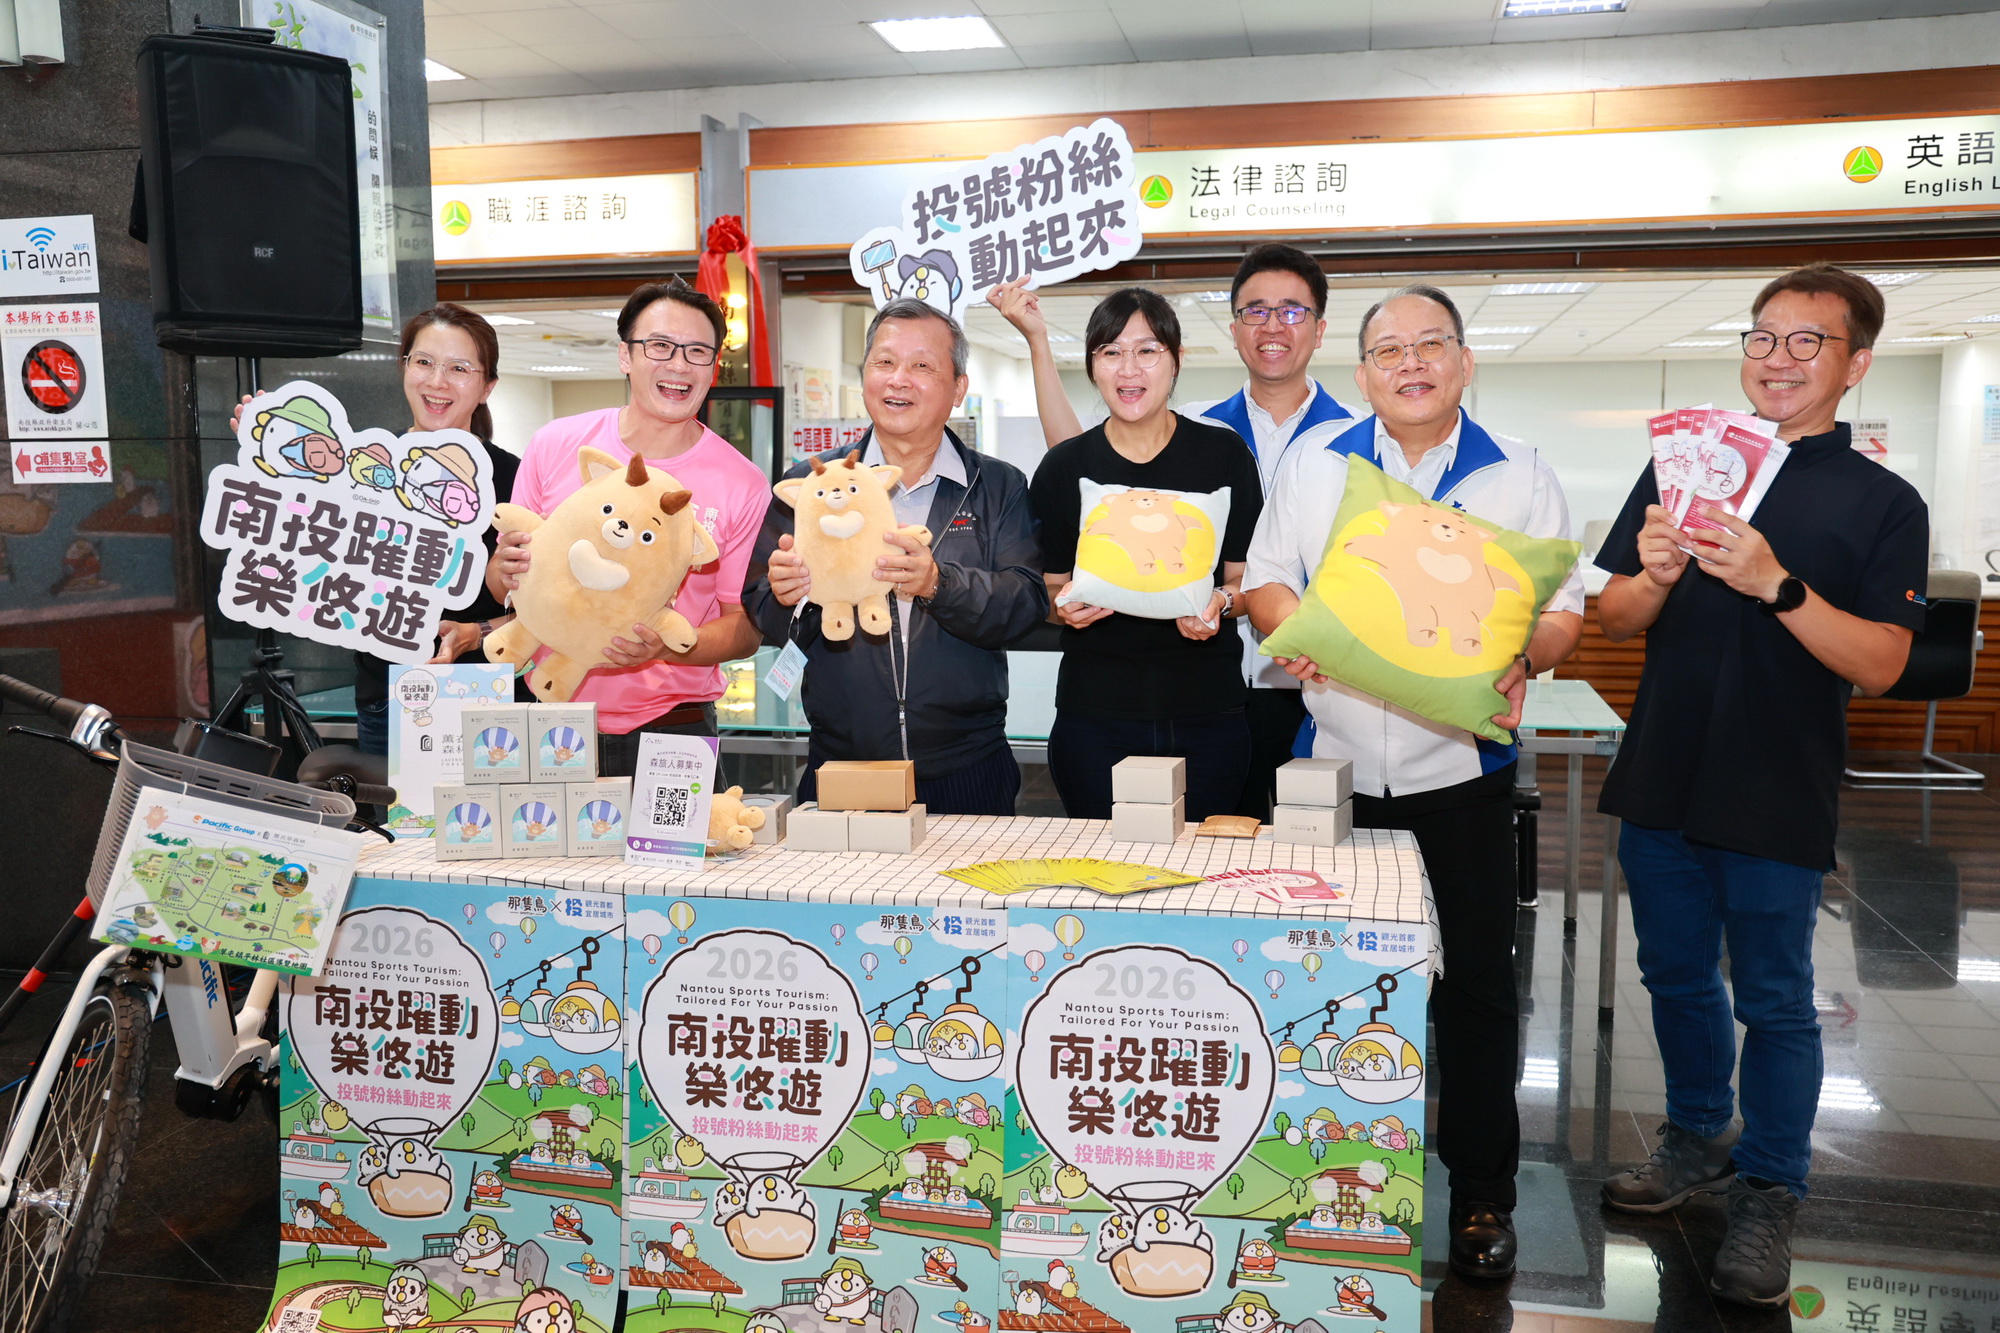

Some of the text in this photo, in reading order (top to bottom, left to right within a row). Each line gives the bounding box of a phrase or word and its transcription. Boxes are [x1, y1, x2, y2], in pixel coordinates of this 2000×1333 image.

[1907, 131, 1995, 169] 英語
[913, 132, 1123, 245] 投號粉絲
[1191, 162, 1347, 197] 法律諮詢
[1905, 177, 1982, 197] English
[488, 193, 627, 223] 職涯諮詢
[1190, 202, 1345, 221] Legal Counseling
[254, 247, 274, 257] RCF
[969, 199, 1131, 291] 動起來
[5, 310, 96, 324] 本場所全面禁菸
[34, 452, 87, 465] 哺集乳室
[215, 478, 474, 597] 南投躍動
[232, 549, 430, 651] 樂悠遊
[650, 757, 702, 771] 森旅人募集中
[202, 818, 256, 835] Pacific Group
[508, 896, 547, 913] 那隻鳥
[585, 900, 613, 908] 觀光首都
[585, 910, 614, 919] 宜居城市
[880, 914, 924, 931] 那隻鳥
[965, 917, 996, 926] 觀光首都
[350, 923, 434, 958] 2026
[965, 927, 996, 936] 宜居城市
[1288, 929, 1335, 947] 那隻鳥
[1381, 932, 1416, 942] 觀光首都
[1381, 944, 1415, 953] 宜居城市
[326, 957, 462, 976] Nantou Sports Tourism:
[706, 946, 799, 982] 2026
[199, 959, 219, 1009] acific
[322, 968, 469, 988] Tailored For Your Passion
[1094, 963, 1196, 1001] 2026
[680, 984, 829, 1000] Nantou Sports Tourism:
[314, 984, 479, 1040] 南投躍動
[676, 995, 838, 1012] Tailored For Your Passion
[1064, 1002, 1229, 1020] Nantou Sports Tourism:
[1059, 1015, 1239, 1033] Tailored For Your Passion
[667, 1012, 848, 1067] 南投躍動
[331, 1031, 455, 1085] 樂悠遊
[1050, 1032, 1250, 1091] 南投躍動
[337, 1083, 452, 1111] 投號粉絲動起來
[685, 1061, 822, 1116] 樂悠遊
[1068, 1085, 1220, 1142] 樂悠遊
[692, 1115, 818, 1143] 投號粉絲動起來
[1075, 1143, 1216, 1171] 投號粉絲動起來
